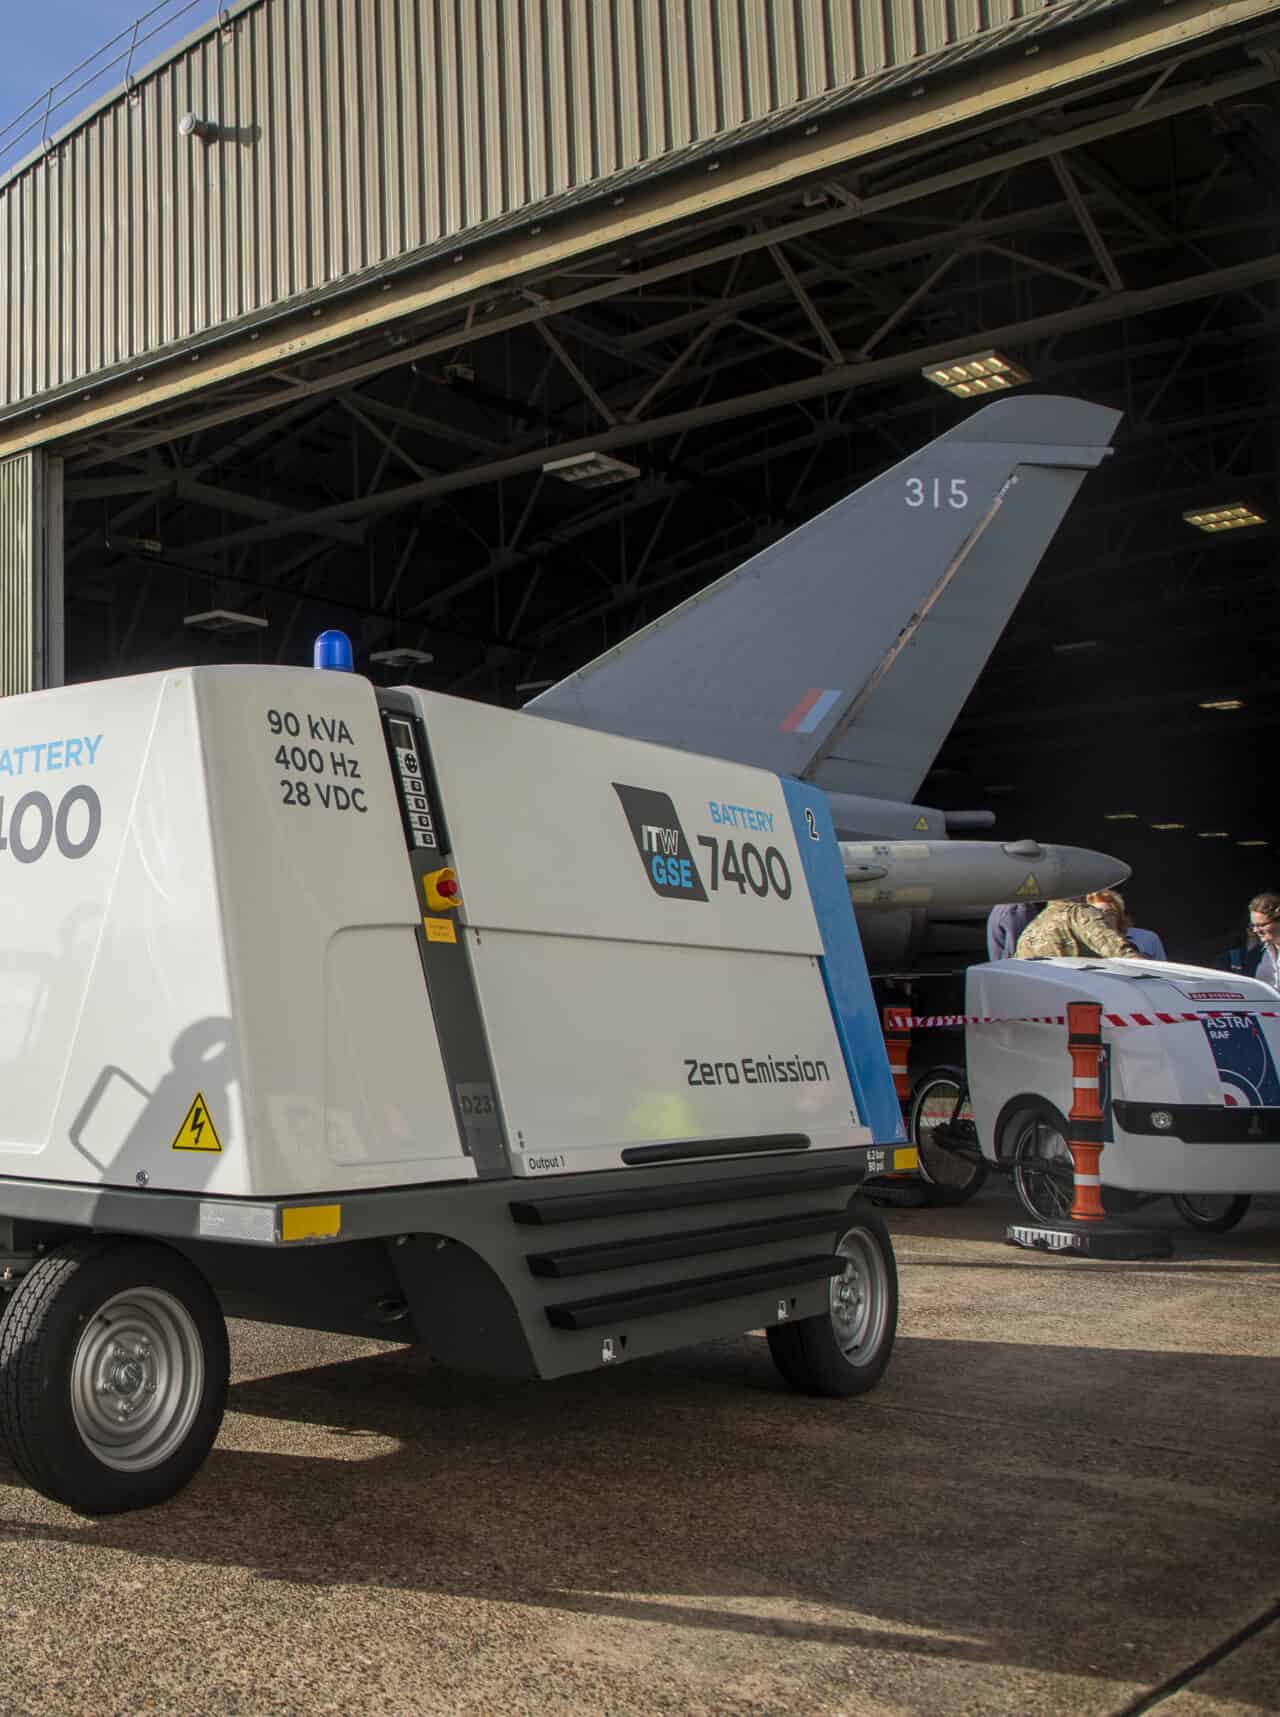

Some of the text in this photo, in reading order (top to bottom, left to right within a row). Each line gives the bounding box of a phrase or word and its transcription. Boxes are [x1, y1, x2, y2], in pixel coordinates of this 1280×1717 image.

[905, 477, 969, 509] 315
[267, 709, 355, 746] 90 kVA
[275, 745, 361, 779] 400 Hz
[280, 780, 368, 813] 28 VDC
[707, 801, 775, 833] BATTERY
[641, 824, 679, 855] ITW
[651, 855, 694, 888] GSE
[697, 834, 792, 900] 7400
[1207, 1015, 1254, 1029] ASTRA
[684, 1053, 830, 1086] Zero Emission
[528, 1155, 560, 1170] Output
